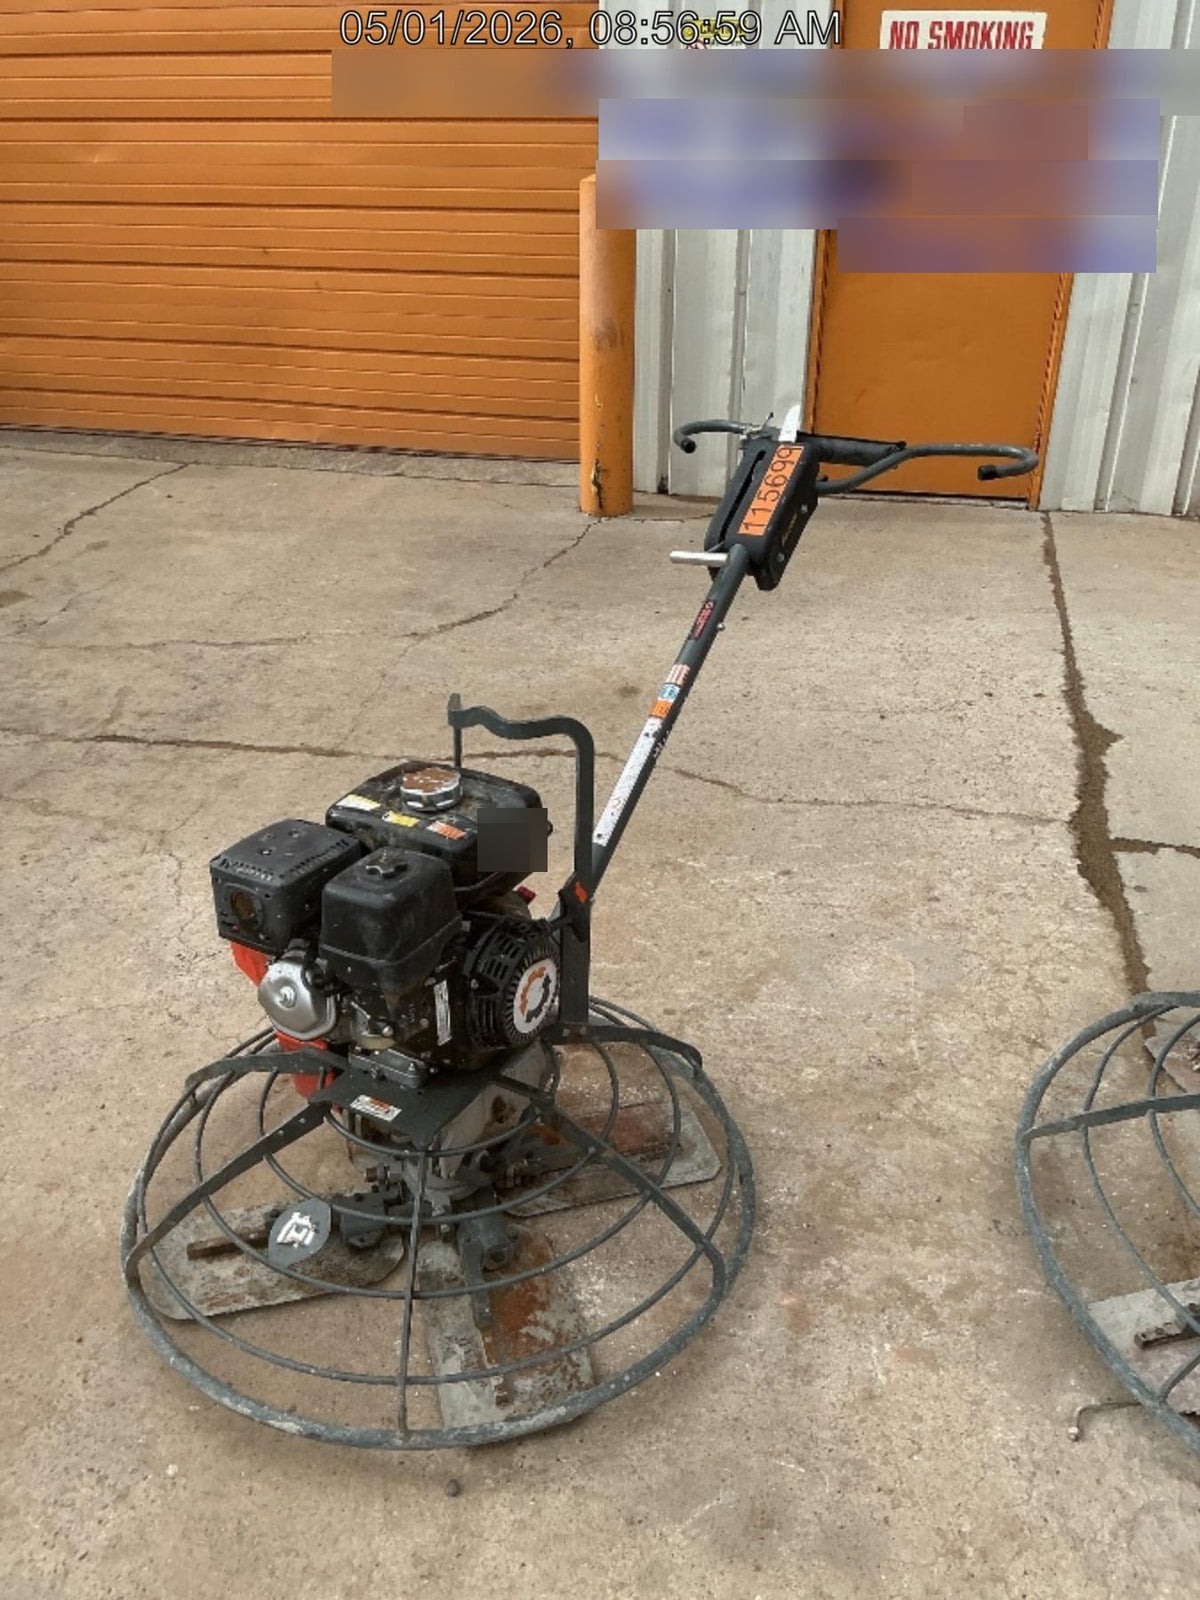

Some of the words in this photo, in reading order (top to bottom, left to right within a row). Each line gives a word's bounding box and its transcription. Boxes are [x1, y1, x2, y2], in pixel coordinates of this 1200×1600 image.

[889, 20, 920, 49] NO
[927, 20, 1035, 49] SMOKING
[744, 445, 804, 531] 115699
